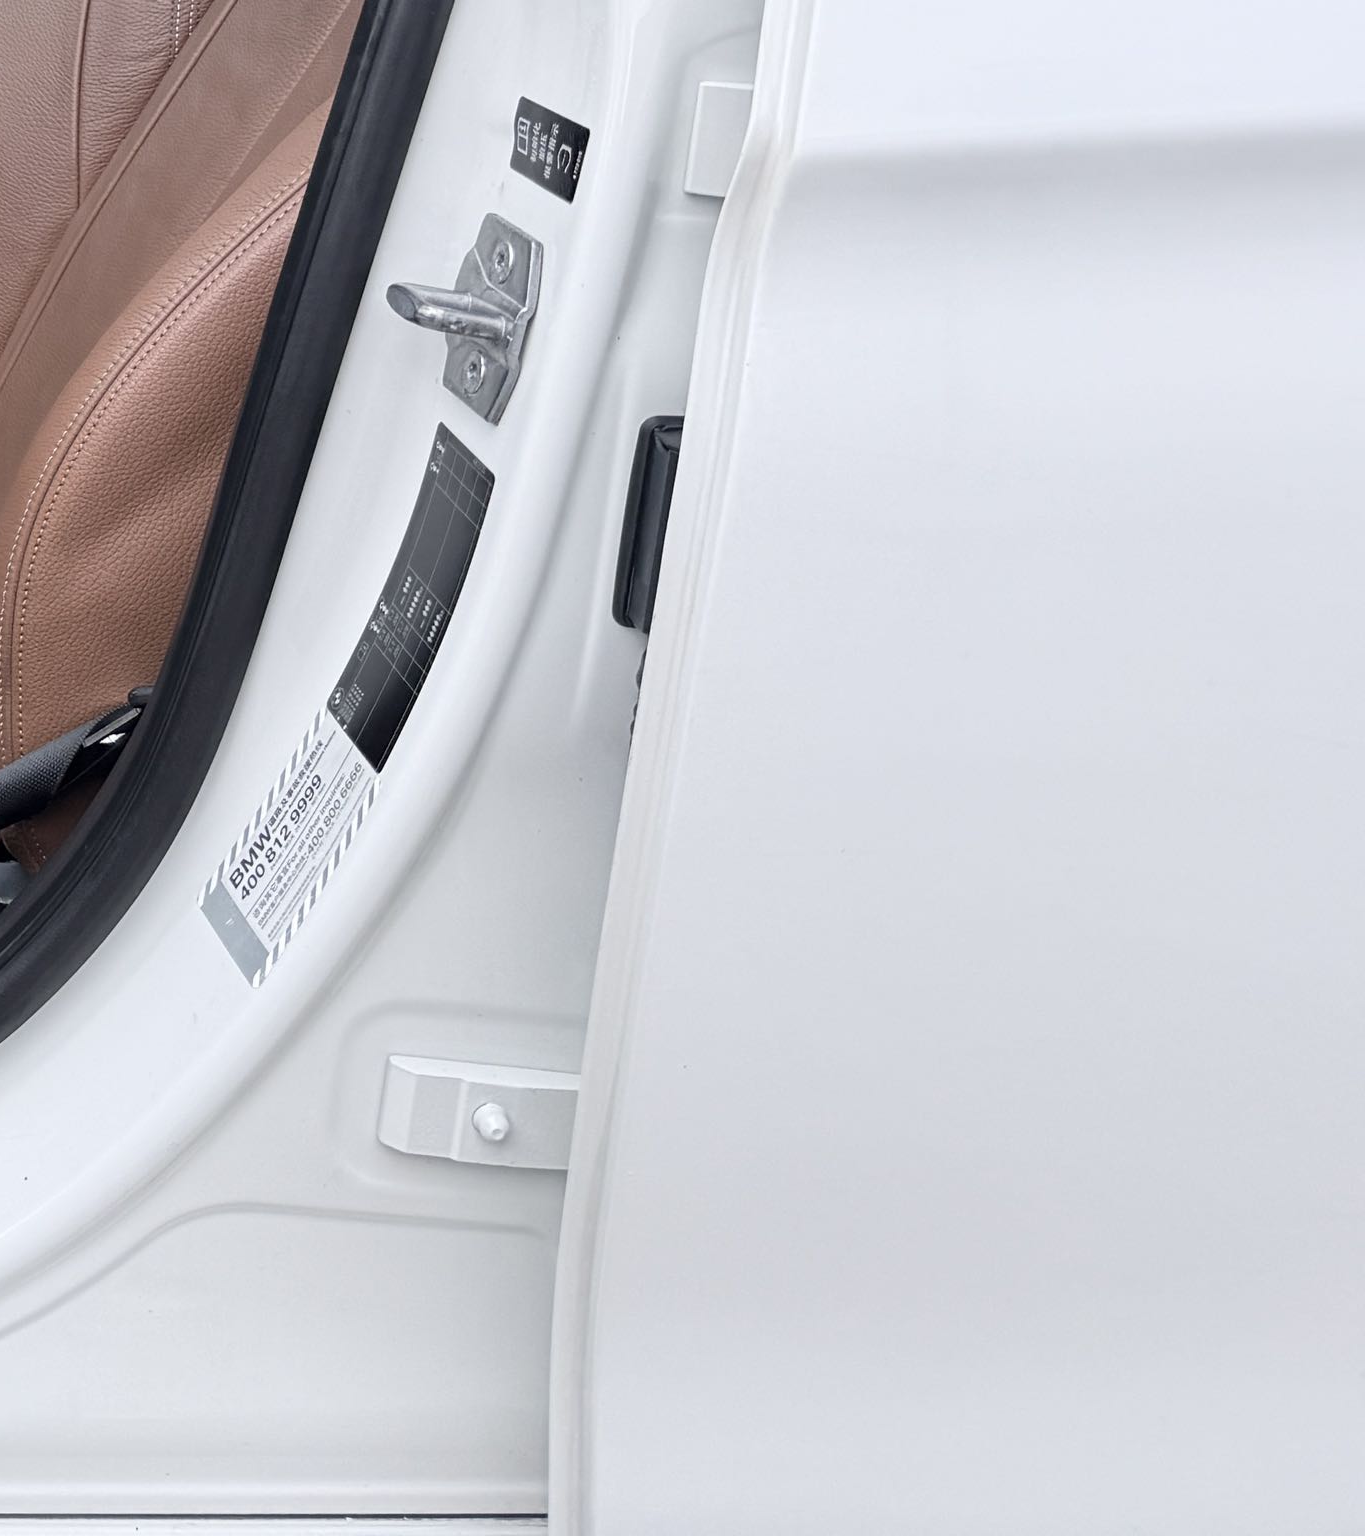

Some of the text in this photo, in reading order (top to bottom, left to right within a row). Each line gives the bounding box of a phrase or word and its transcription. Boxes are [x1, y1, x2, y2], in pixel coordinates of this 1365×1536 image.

[238, 860, 266, 903] 400
[263, 822, 291, 865] 812
[288, 772, 323, 825] 9999
[305, 825, 324, 856] 400
[322, 797, 341, 827] 800
[338, 760, 363, 799] 6666
[228, 822, 273, 891] BMW
